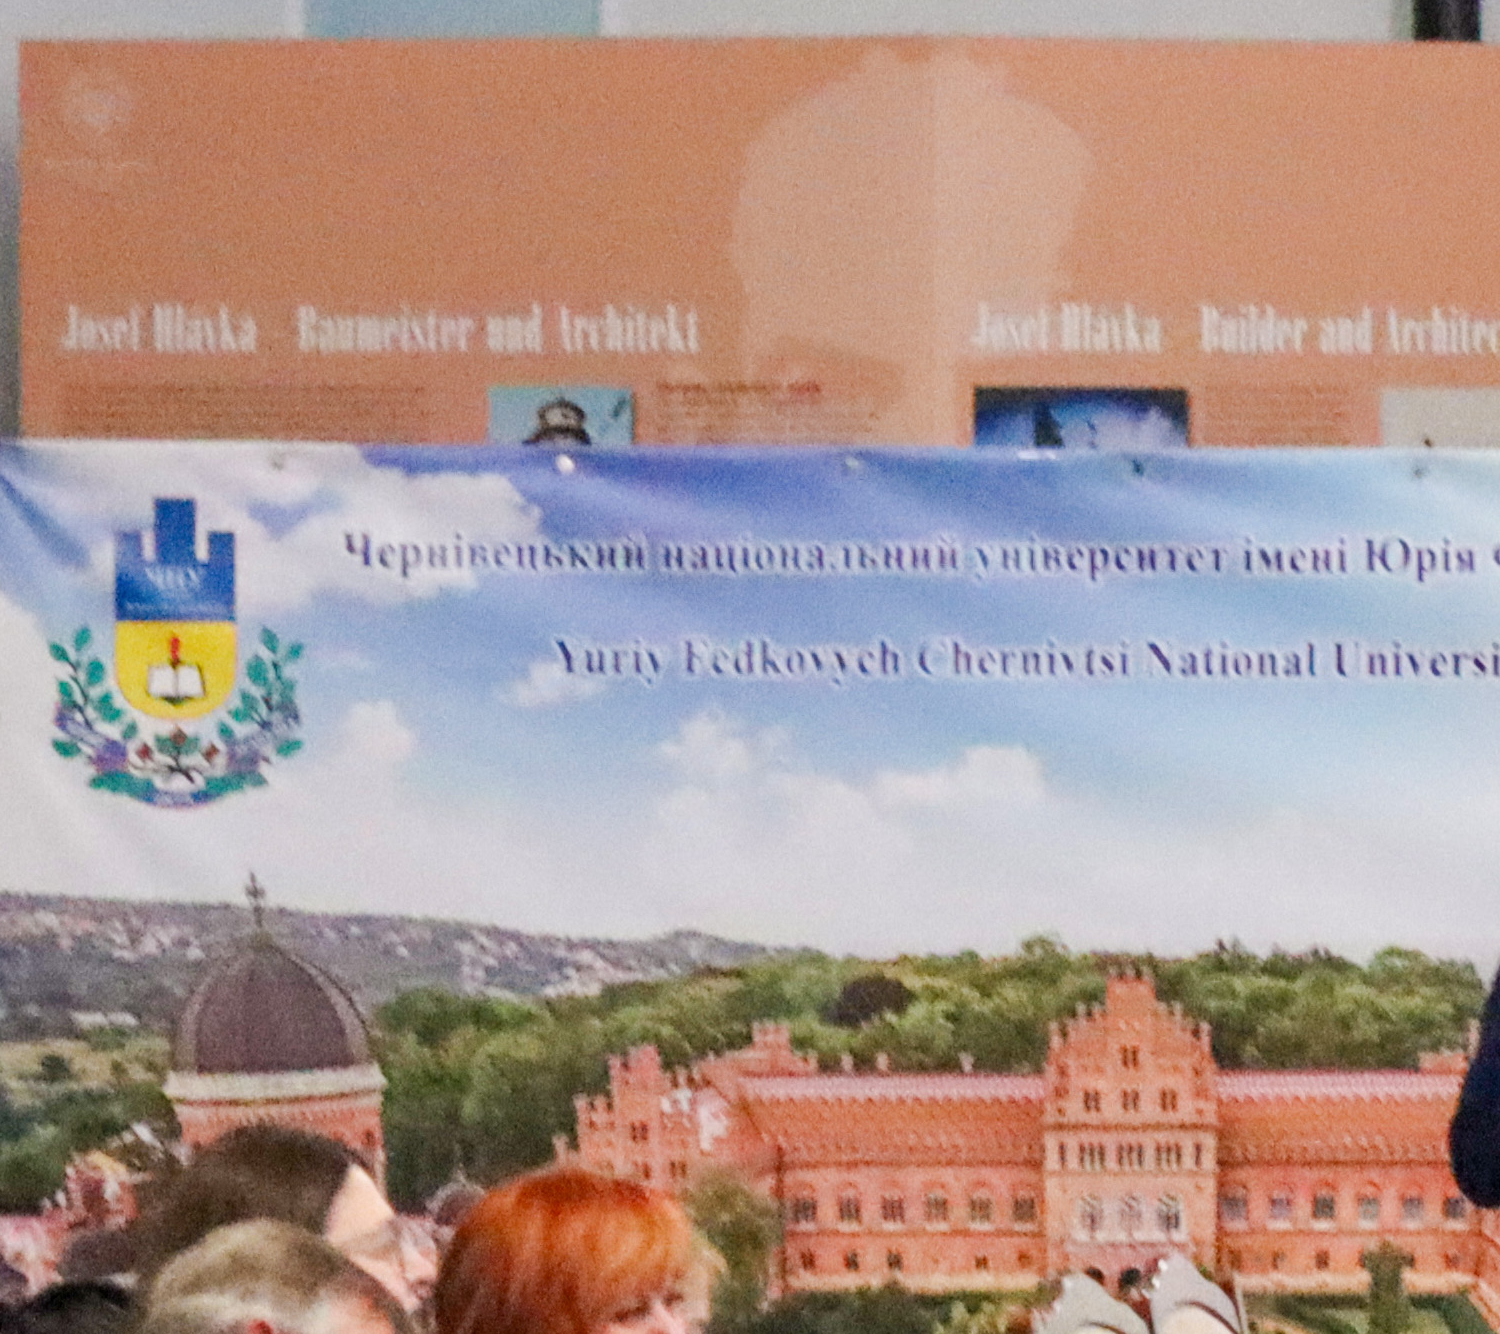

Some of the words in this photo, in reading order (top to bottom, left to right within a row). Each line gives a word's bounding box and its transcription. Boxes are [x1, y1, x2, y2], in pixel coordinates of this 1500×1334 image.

[299, 303, 475, 353] Baumeister
[487, 304, 542, 352] und
[1201, 304, 1306, 354] Builder
[1319, 306, 1372, 354] and
[344, 531, 646, 578] Чернівецький
[664, 534, 959, 576] національний
[973, 534, 1227, 581] університет
[1243, 537, 1348, 573] імені
[1365, 537, 1477, 582] Юрія
[554, 638, 660, 686] Yuriy
[685, 638, 902, 687] Fedkovych
[918, 639, 1130, 677] Chernivtsi
[1147, 641, 1318, 677] National
